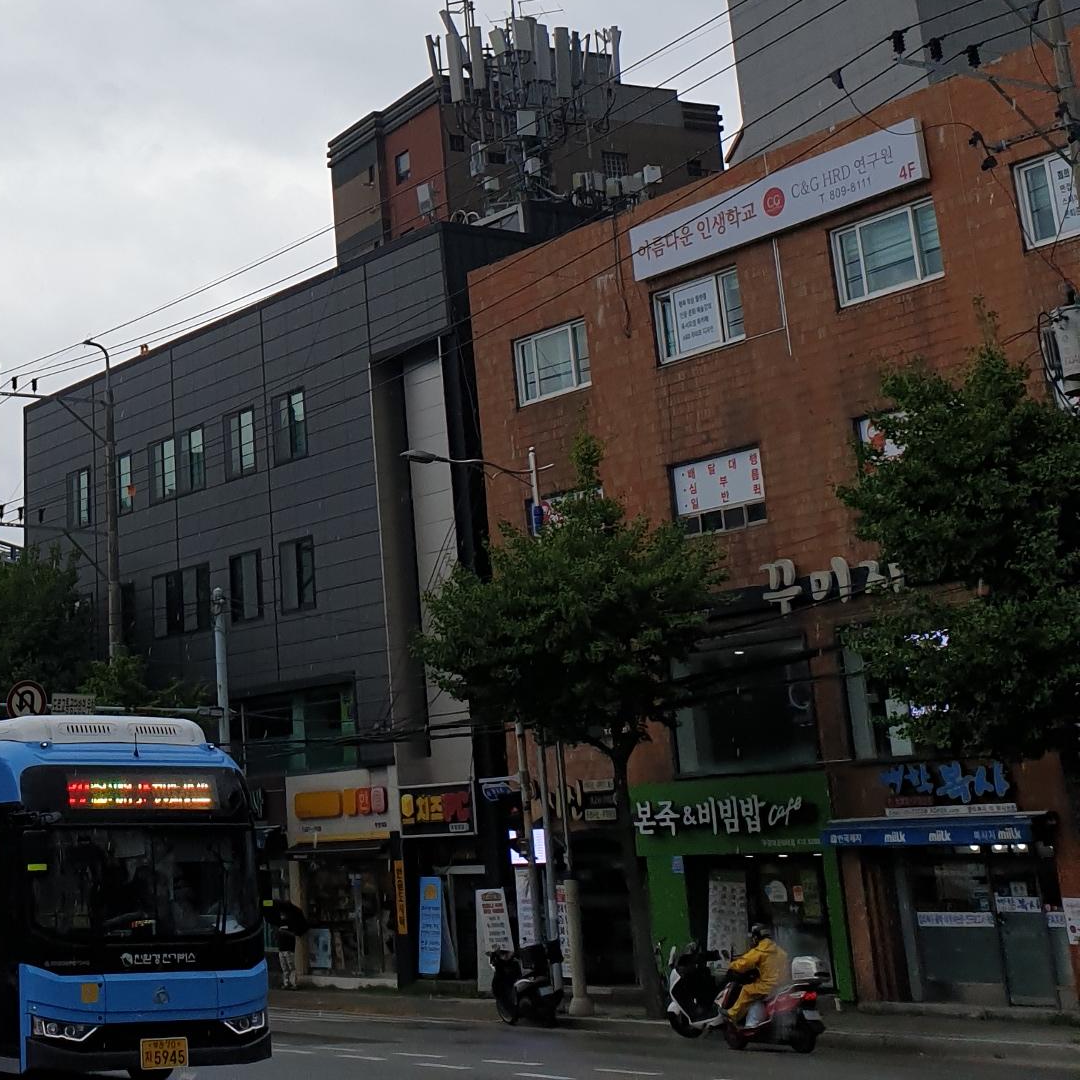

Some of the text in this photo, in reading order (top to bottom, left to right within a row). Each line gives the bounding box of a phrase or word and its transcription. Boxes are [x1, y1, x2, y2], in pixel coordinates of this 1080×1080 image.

[791, 144, 893, 199] C&G HRD 연구원
[899, 161, 916, 180] 4F
[829, 177, 871, 202] 809-8111
[637, 202, 758, 261] 아름다운 인생학교
[154, 1049, 185, 1065] 5945
